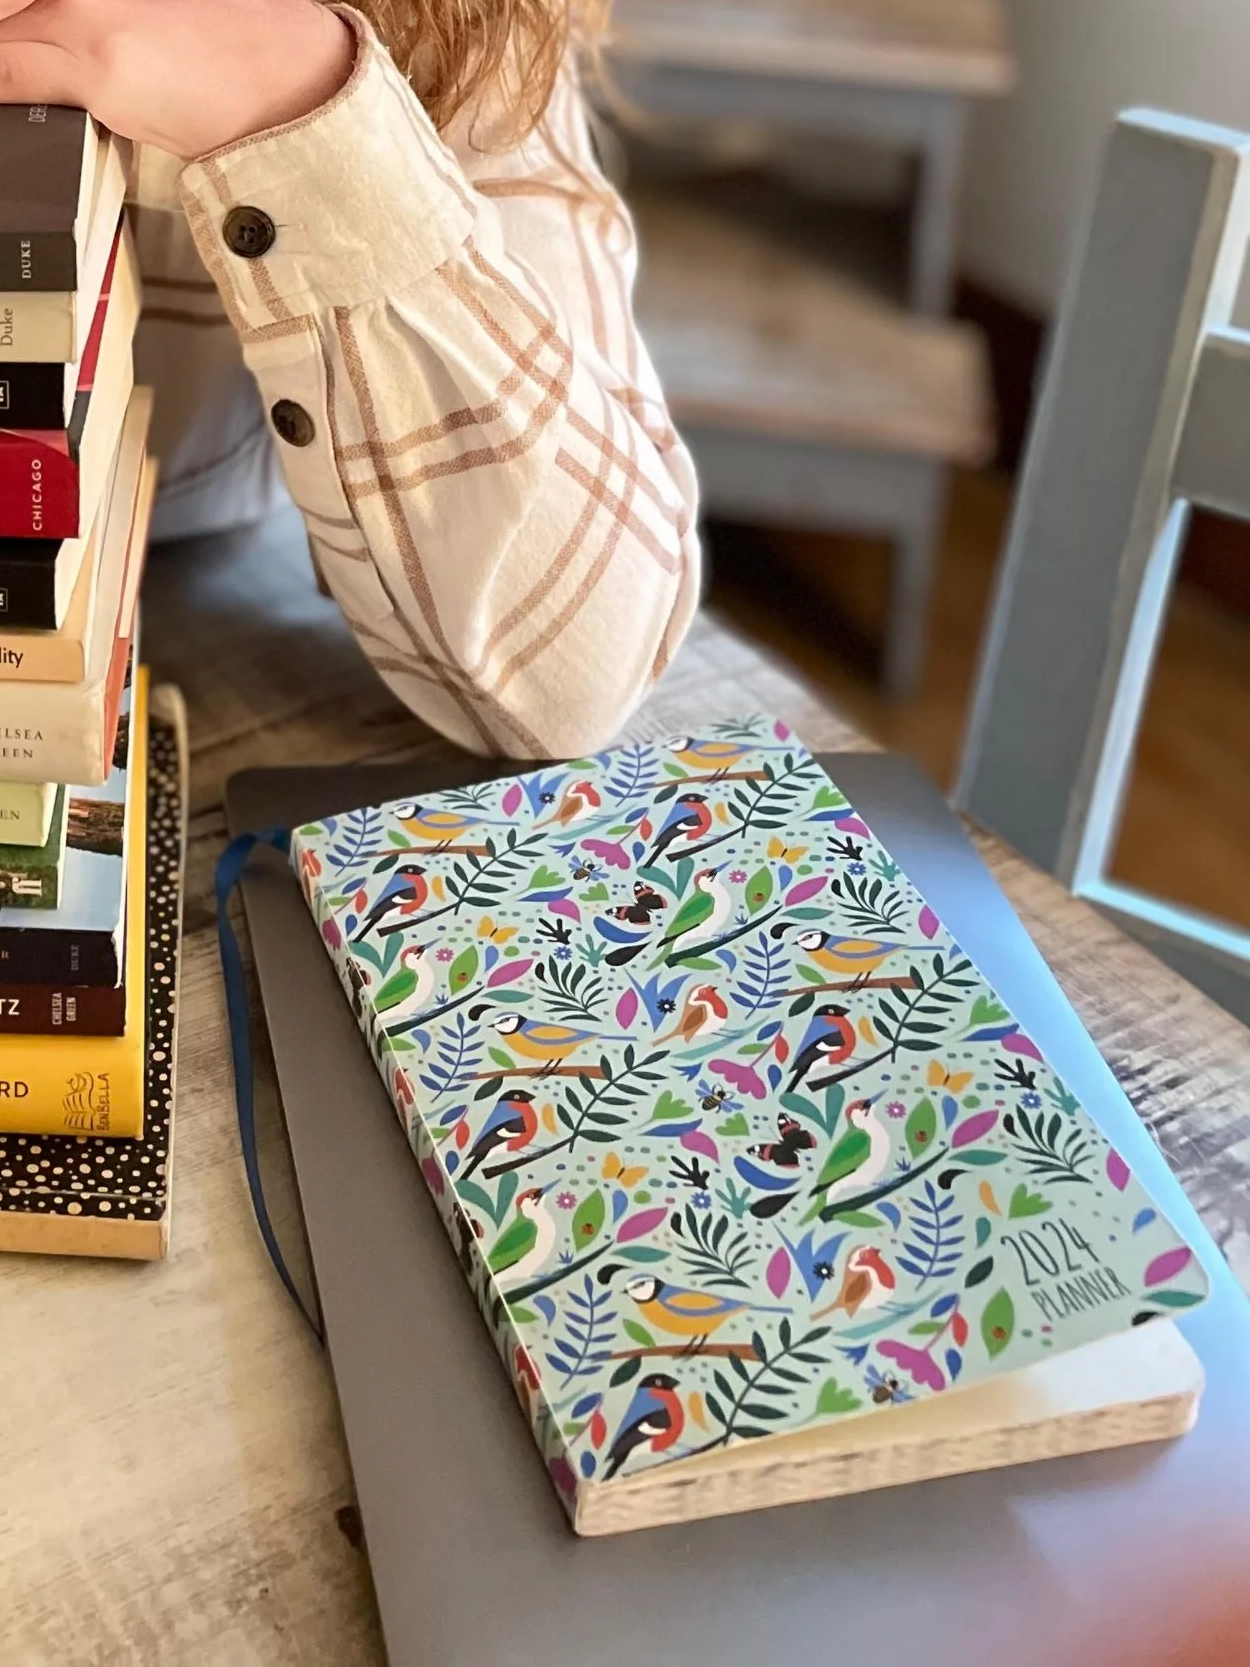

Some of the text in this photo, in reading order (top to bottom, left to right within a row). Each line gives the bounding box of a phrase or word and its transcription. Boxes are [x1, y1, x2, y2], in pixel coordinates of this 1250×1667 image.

[20, 240, 32, 279] DUKE
[0, 307, 14, 347] Duke
[31, 459, 43, 531] CHICAGO
[1000, 1217, 1100, 1287] 2024
[1030, 1266, 1133, 1323] PLANNER
